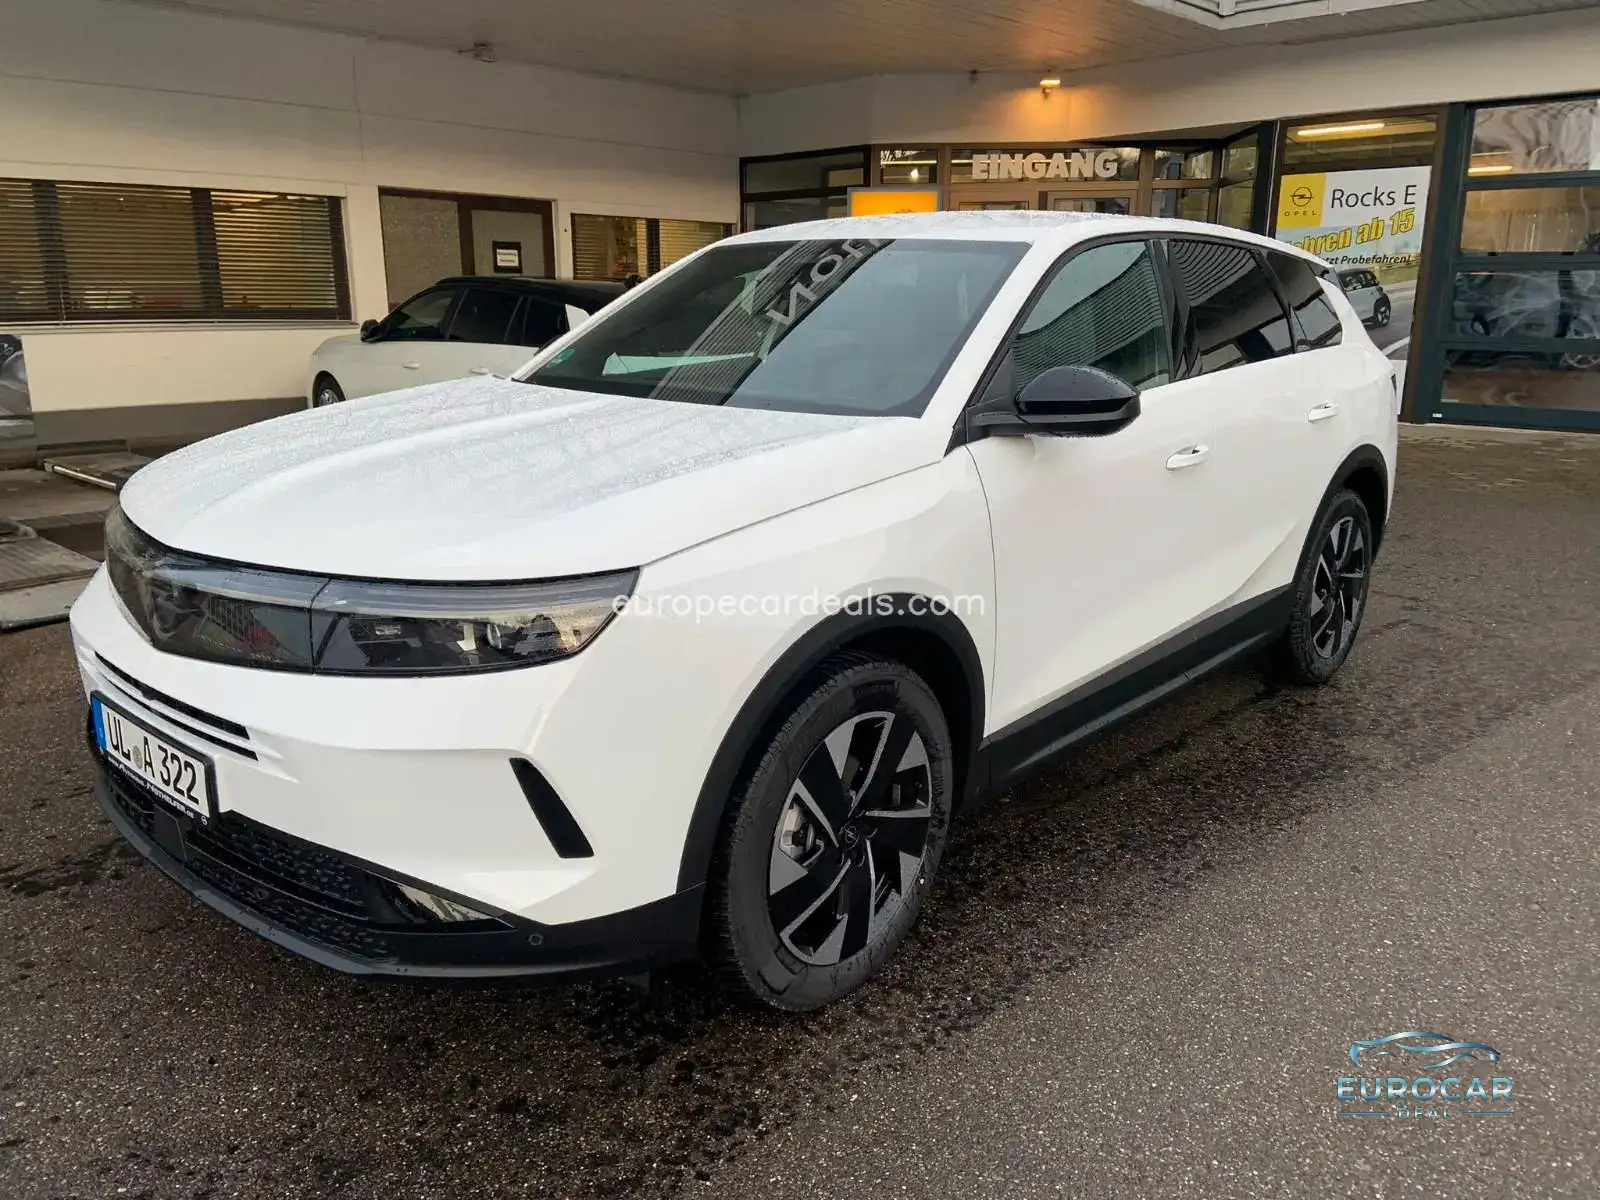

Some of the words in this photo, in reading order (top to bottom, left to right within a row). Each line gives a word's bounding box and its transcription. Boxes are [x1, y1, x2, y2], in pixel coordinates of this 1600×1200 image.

[971, 151, 1118, 180] EINGANG
[1331, 185, 1395, 208] Rocks
[1404, 184, 1417, 205] E
[1288, 228, 1352, 256] hren
[1356, 216, 1385, 244] ab
[1390, 207, 1415, 235] 15
[1340, 254, 1412, 265] Probefahren!
[107, 711, 131, 762] UL
[143, 736, 155, 778] A
[158, 744, 199, 806] 322
